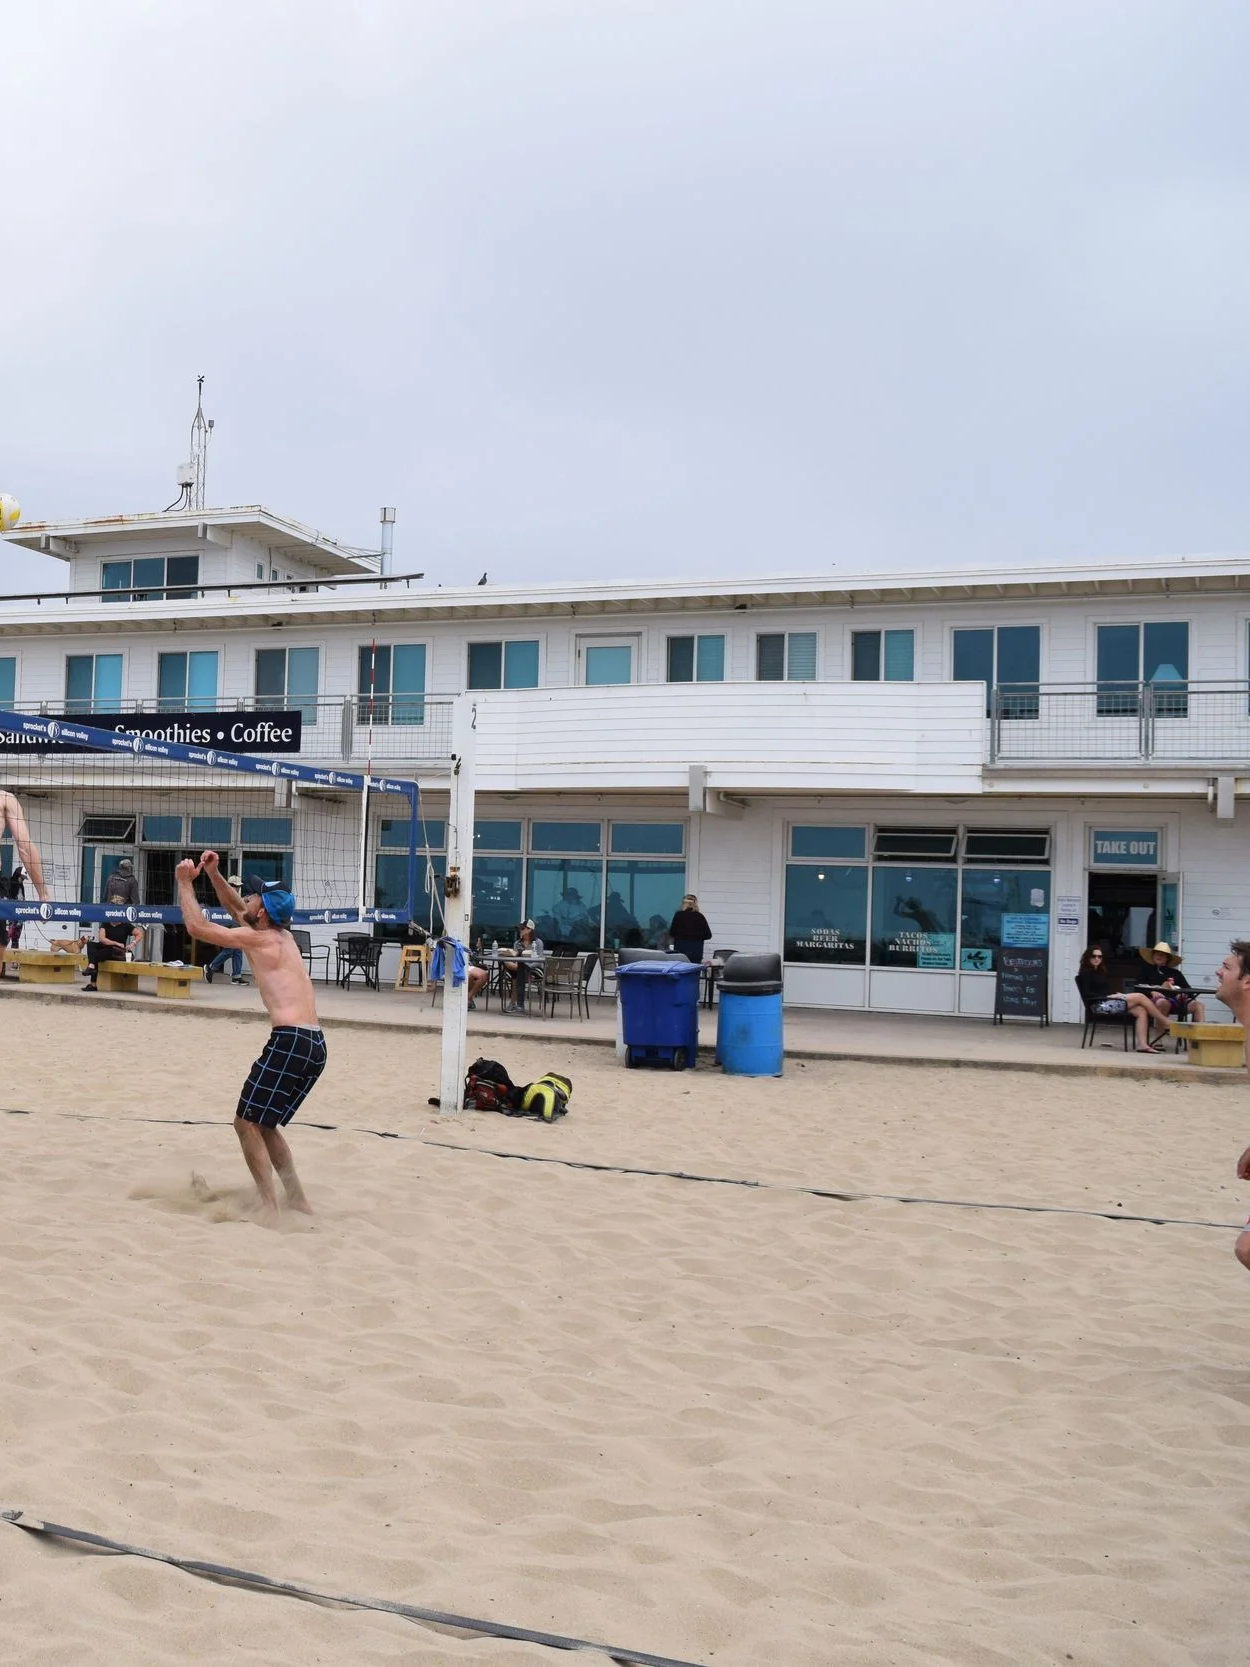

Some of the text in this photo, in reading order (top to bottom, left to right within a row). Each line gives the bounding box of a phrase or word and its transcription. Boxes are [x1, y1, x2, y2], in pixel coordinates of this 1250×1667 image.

[231, 722, 293, 743] Coffee
[1095, 840, 1156, 855] TAKE OUT
[69, 909, 81, 917] volley
[811, 928, 840, 936] SODAS
[899, 931, 928, 939] TACOS
[796, 941, 855, 949] MARGARITAS
[894, 938, 932, 946] NACHOS
[889, 944, 938, 953] BURRITOS
